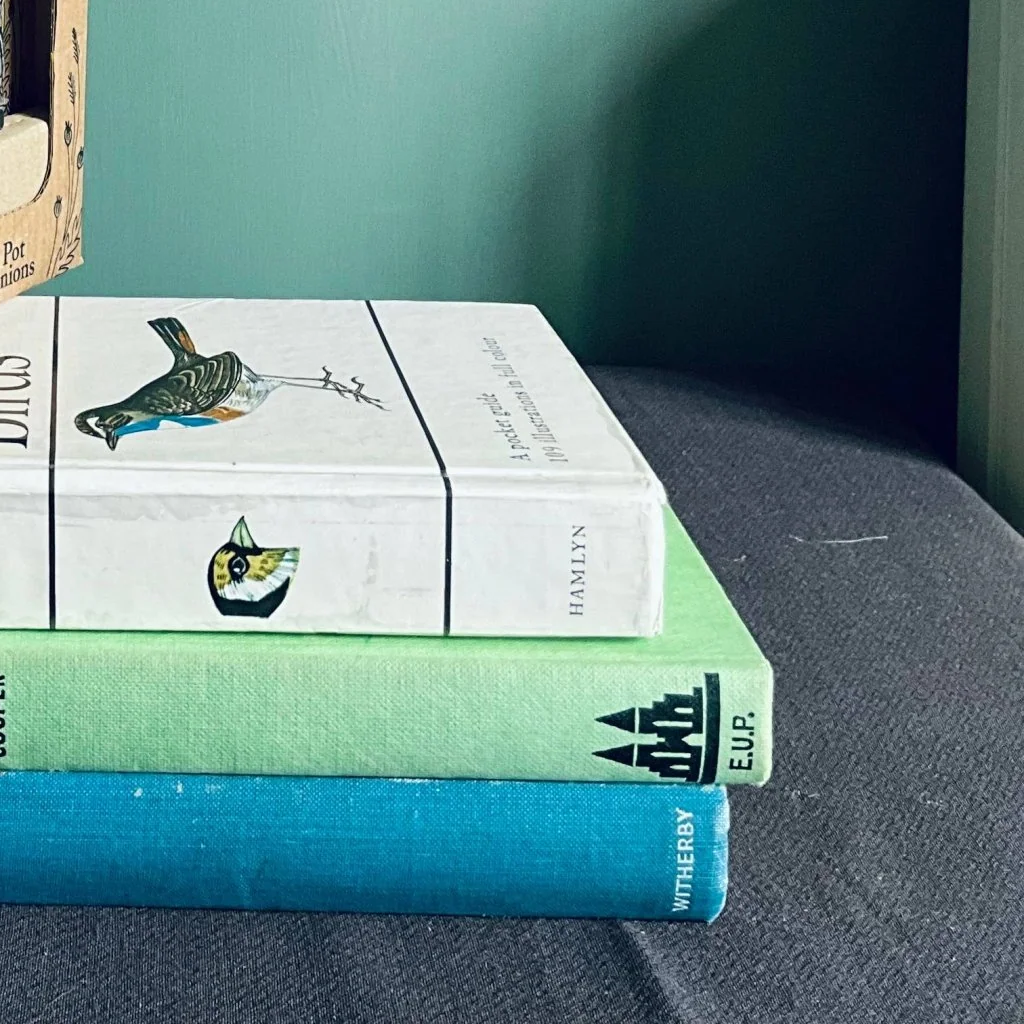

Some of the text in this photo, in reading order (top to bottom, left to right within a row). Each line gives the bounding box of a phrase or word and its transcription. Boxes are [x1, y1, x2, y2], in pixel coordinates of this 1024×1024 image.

[3, 240, 26, 268] Pot
[482, 337, 507, 361] colour
[491, 363, 518, 378] full
[506, 380, 524, 389] in
[476, 392, 532, 461] A pocket guide
[515, 391, 559, 444] illustrations
[569, 524, 586, 616] HAMLYN
[729, 711, 756, 772] E.U.P.
[671, 807, 695, 912] WITHERBY
